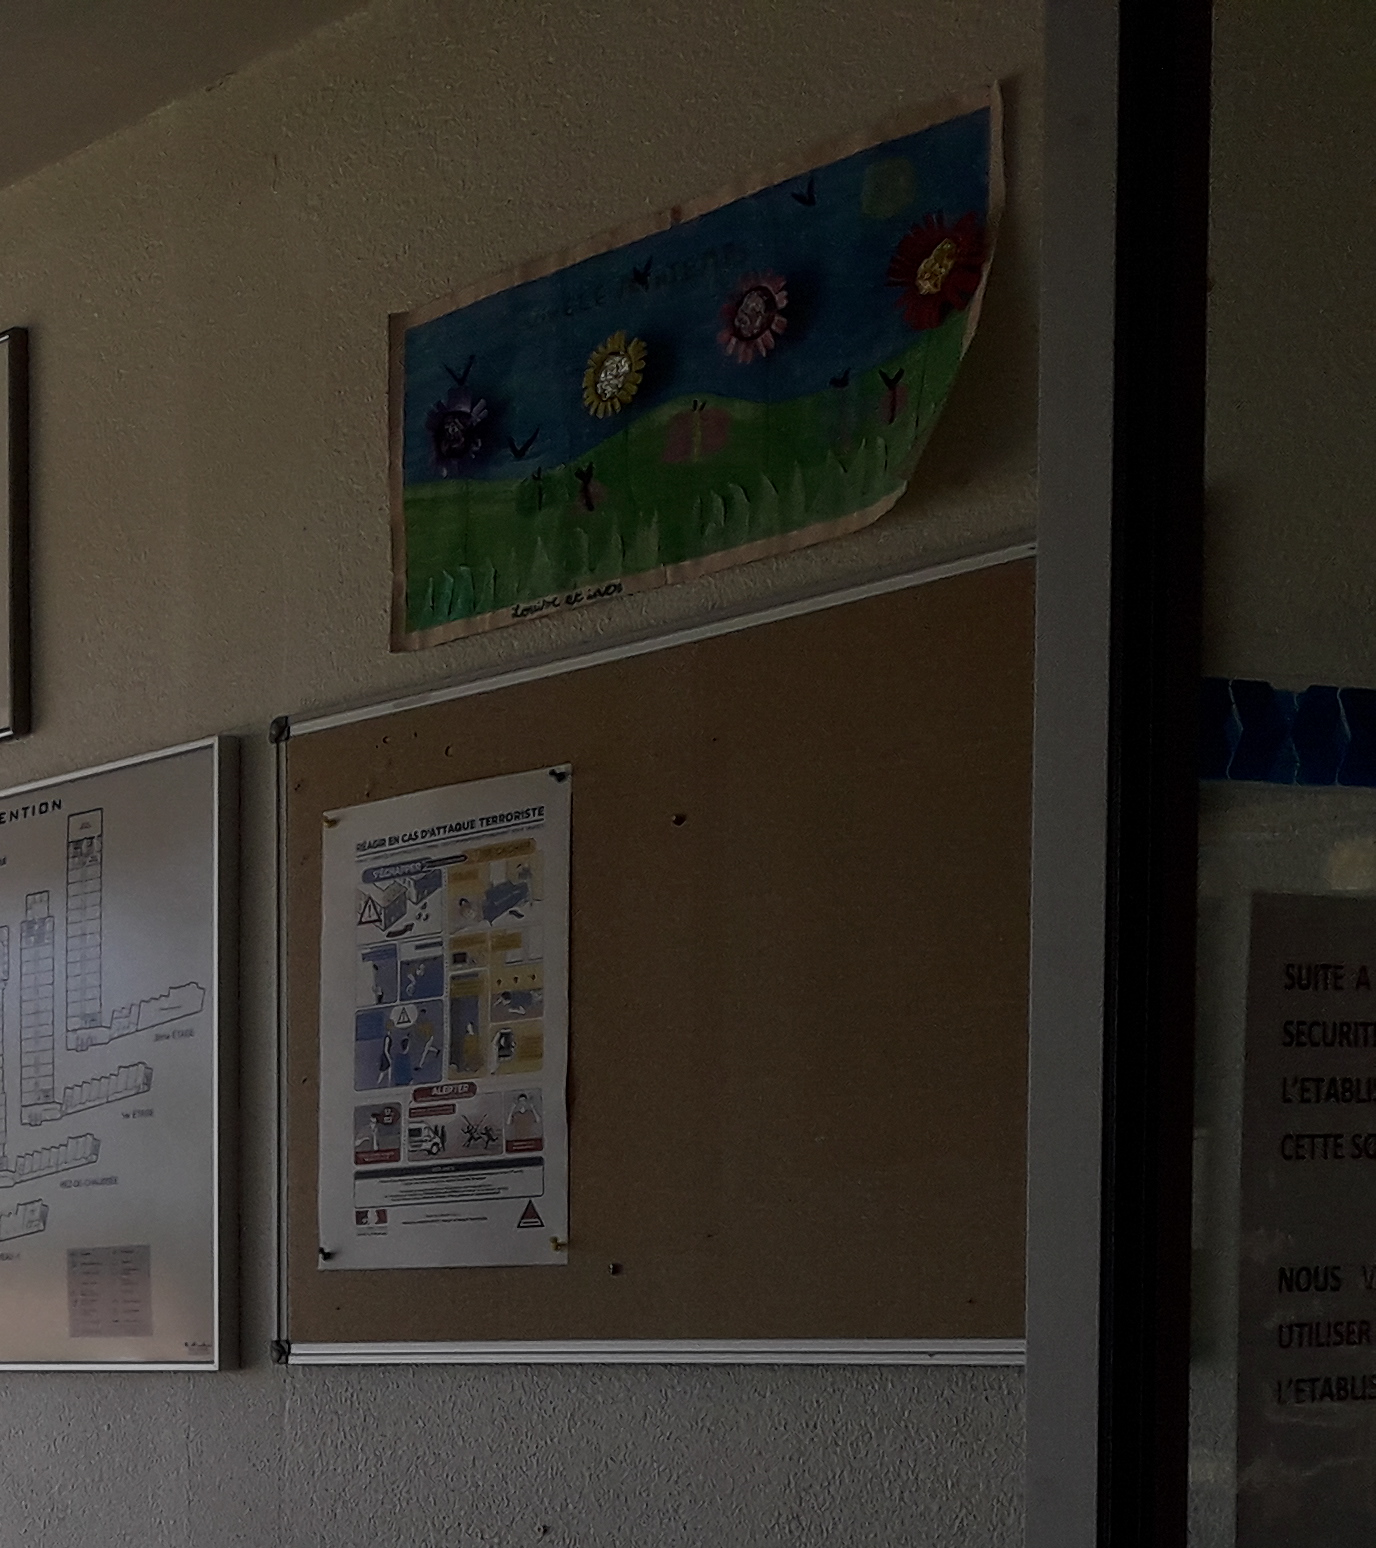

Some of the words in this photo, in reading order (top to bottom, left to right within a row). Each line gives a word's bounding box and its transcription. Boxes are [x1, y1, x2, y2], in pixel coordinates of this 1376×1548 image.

[388, 835, 400, 846] EN
[401, 830, 419, 843] CAS
[420, 819, 476, 840] D'ATTAQUE
[479, 805, 545, 828] TERRORISTE
[1283, 964, 1345, 991] SUITE
[1355, 965, 1370, 991] A
[1282, 1020, 1376, 1048] SECURIT
[1281, 1133, 1344, 1162] CETTE
[1278, 1266, 1342, 1293] NOUS
[1361, 1269, 1376, 1291] V
[1278, 1320, 1371, 1349] UTILISER
